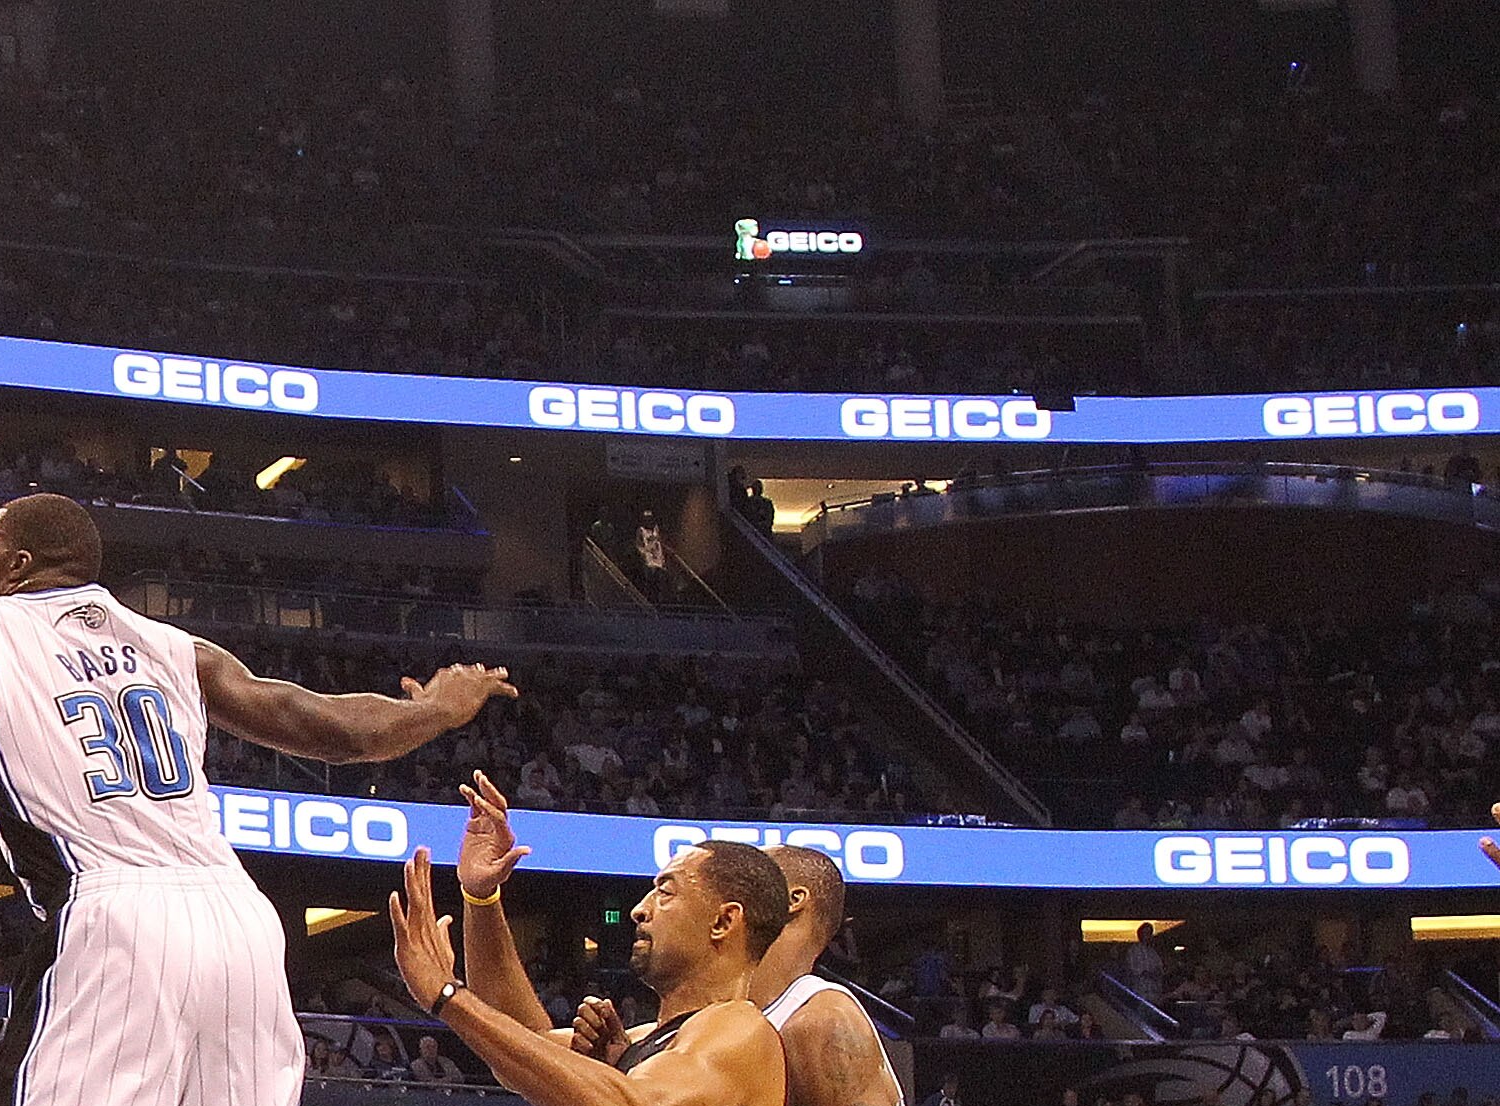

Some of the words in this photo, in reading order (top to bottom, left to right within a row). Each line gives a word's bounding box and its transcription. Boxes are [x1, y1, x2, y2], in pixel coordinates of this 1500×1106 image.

[766, 231, 863, 253] GEICO
[113, 353, 319, 411] GEICO
[529, 386, 736, 435] GEICO
[840, 397, 1052, 439] GEICO
[1262, 392, 1480, 437] GEICO
[55, 645, 137, 683] BASS
[54, 683, 195, 803] 30
[1154, 836, 1411, 884] GEICO
[1325, 1065, 1388, 1098] 108
